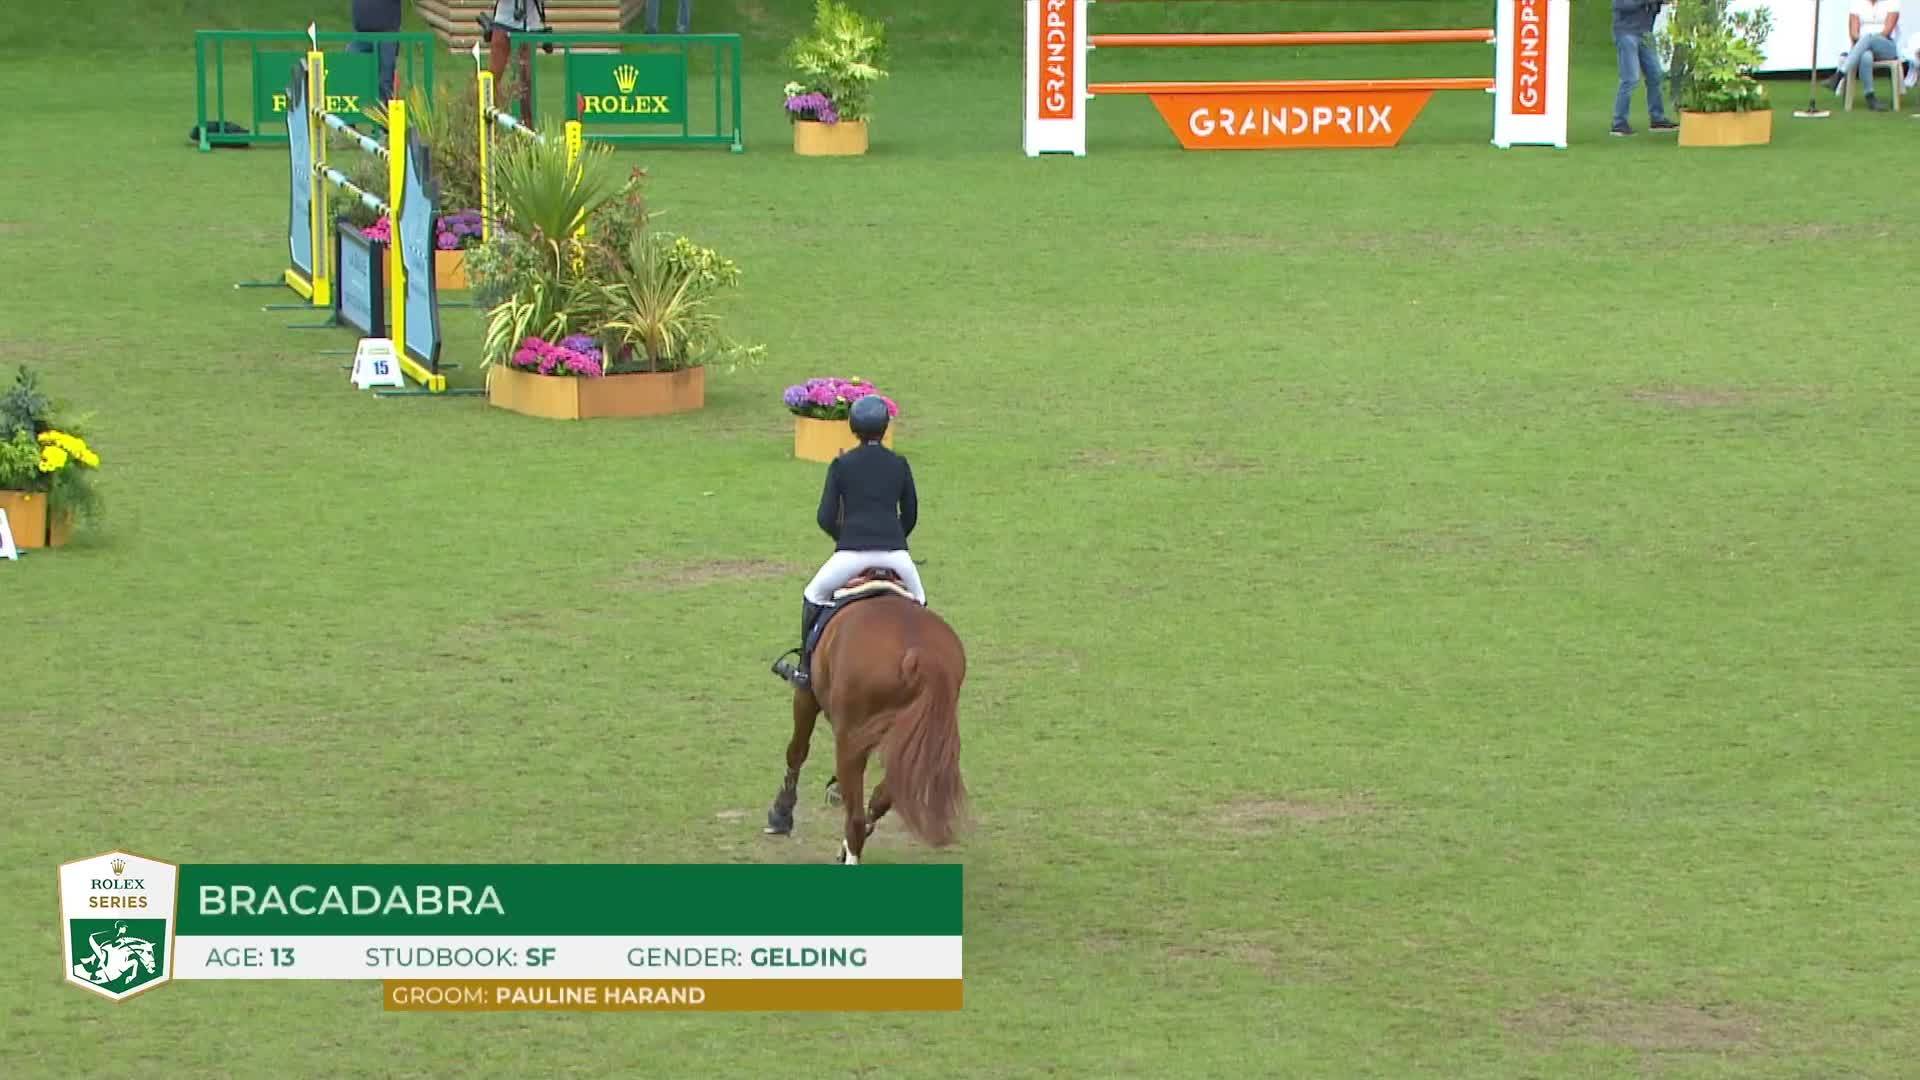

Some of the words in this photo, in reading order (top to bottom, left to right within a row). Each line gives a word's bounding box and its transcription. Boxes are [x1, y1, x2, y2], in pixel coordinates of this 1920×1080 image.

[272, 94, 360, 113] REX
[584, 95, 670, 113] ROLEX
[1189, 105, 1392, 137] GRANDPRIX
[374, 360, 389, 375] 15
